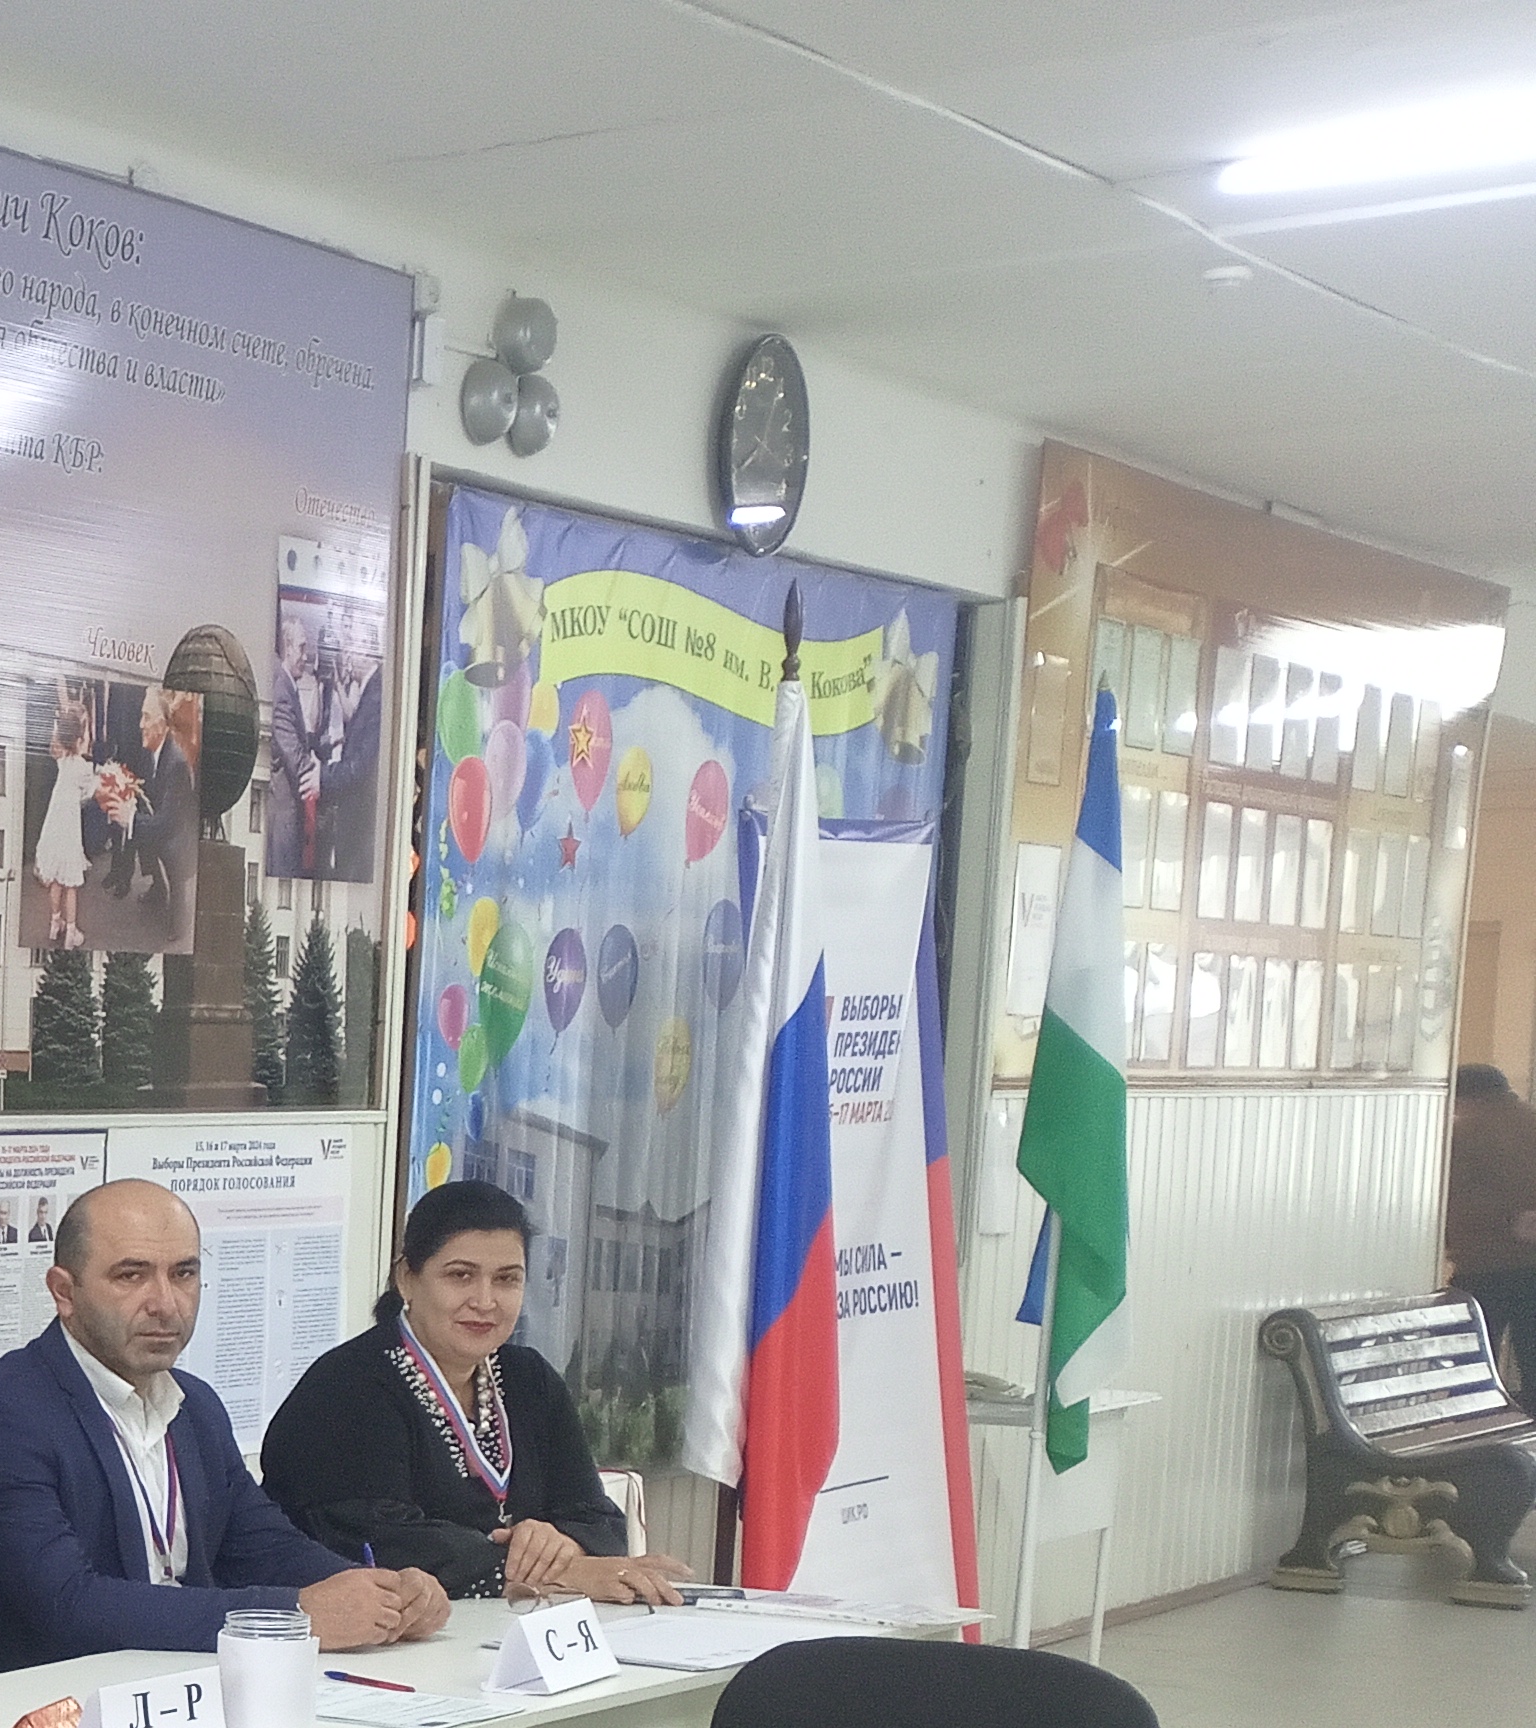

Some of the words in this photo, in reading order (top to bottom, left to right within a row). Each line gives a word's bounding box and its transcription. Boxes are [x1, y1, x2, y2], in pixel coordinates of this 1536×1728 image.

[40, 190, 145, 271] Коков:
[21, 271, 101, 326] народа,
[109, 298, 123, 324] в
[127, 302, 227, 352] конечном
[231, 329, 288, 377] счете,
[295, 336, 375, 391] обречена.
[126, 356, 140, 385] и
[144, 363, 226, 404] власти»
[86, 625, 159, 673] Человек
[550, 605, 611, 643] МКОУ
[685, 626, 716, 661] №8
[724, 649, 750, 681] им.
[840, 994, 903, 1021] ВЫБОРЫ
[830, 1066, 883, 1094] РОССИИ
[849, 1100, 883, 1124] МАРТА
[152, 1156, 185, 1172] Выборы
[186, 1156, 231, 1172] Президента
[170, 1178, 220, 1193] ПОРЯДОК
[222, 1175, 296, 1191] ГОЛОСОВАНИЯ
[855, 1243, 888, 1274] СИЛА
[837, 1289, 852, 1320] ЗА
[853, 1280, 919, 1317] РОССИЮ!
